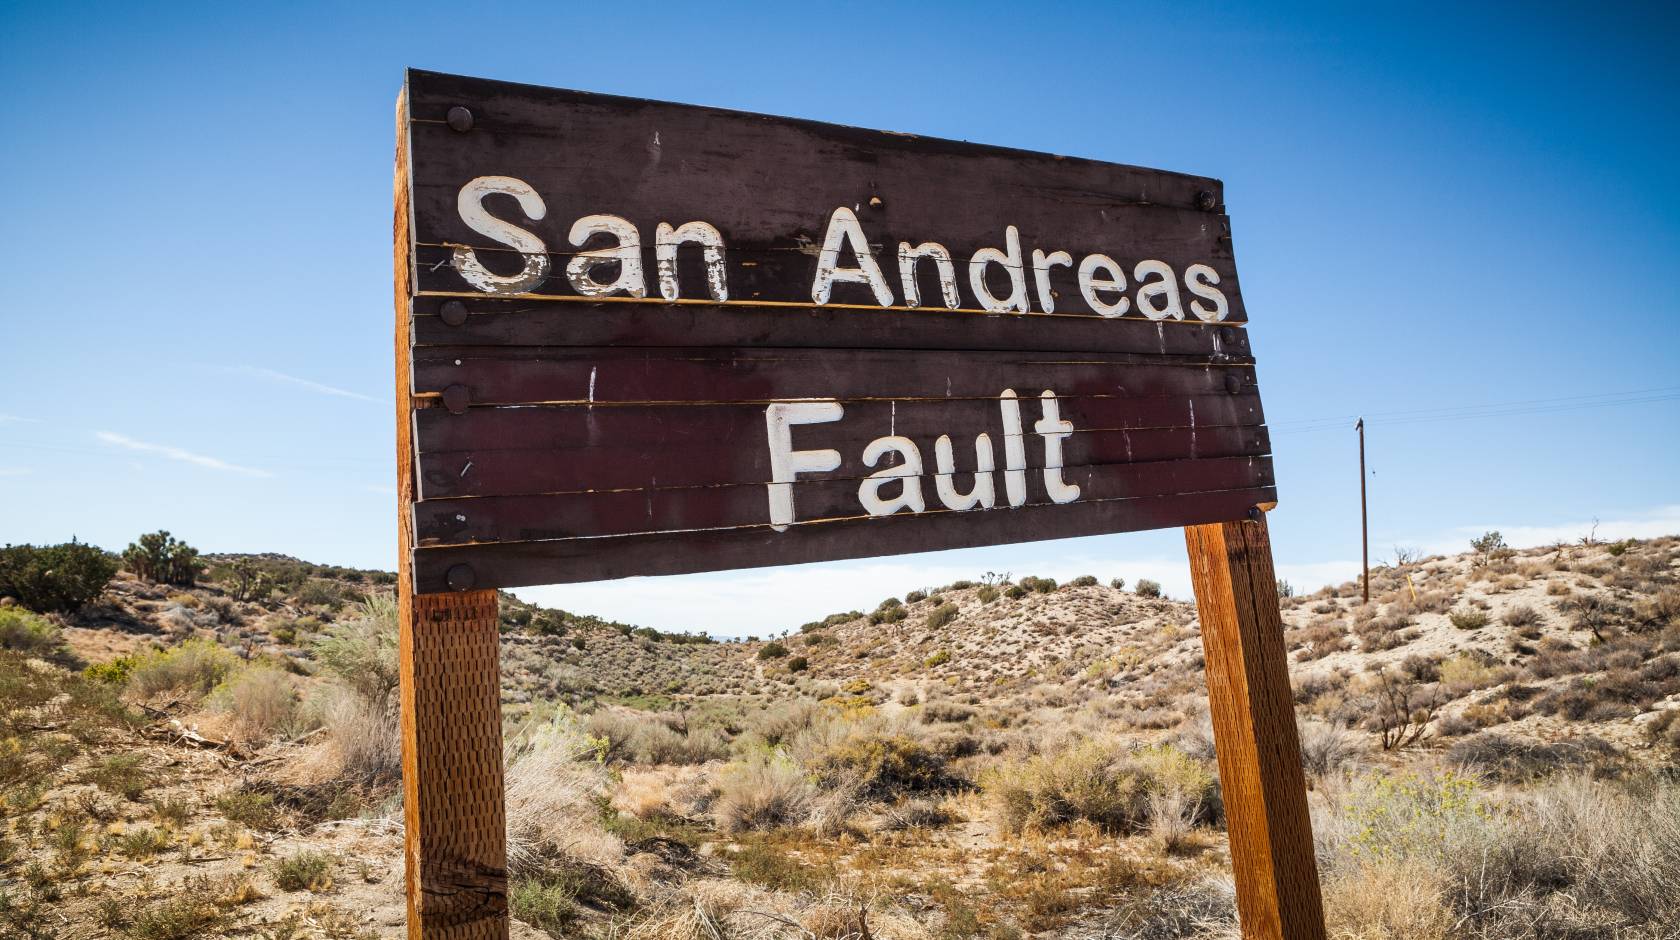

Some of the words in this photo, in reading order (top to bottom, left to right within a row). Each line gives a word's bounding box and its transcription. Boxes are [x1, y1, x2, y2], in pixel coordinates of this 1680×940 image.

[452, 175, 729, 302] San
[811, 206, 1229, 323] Andreas
[765, 388, 1081, 532] Fault
